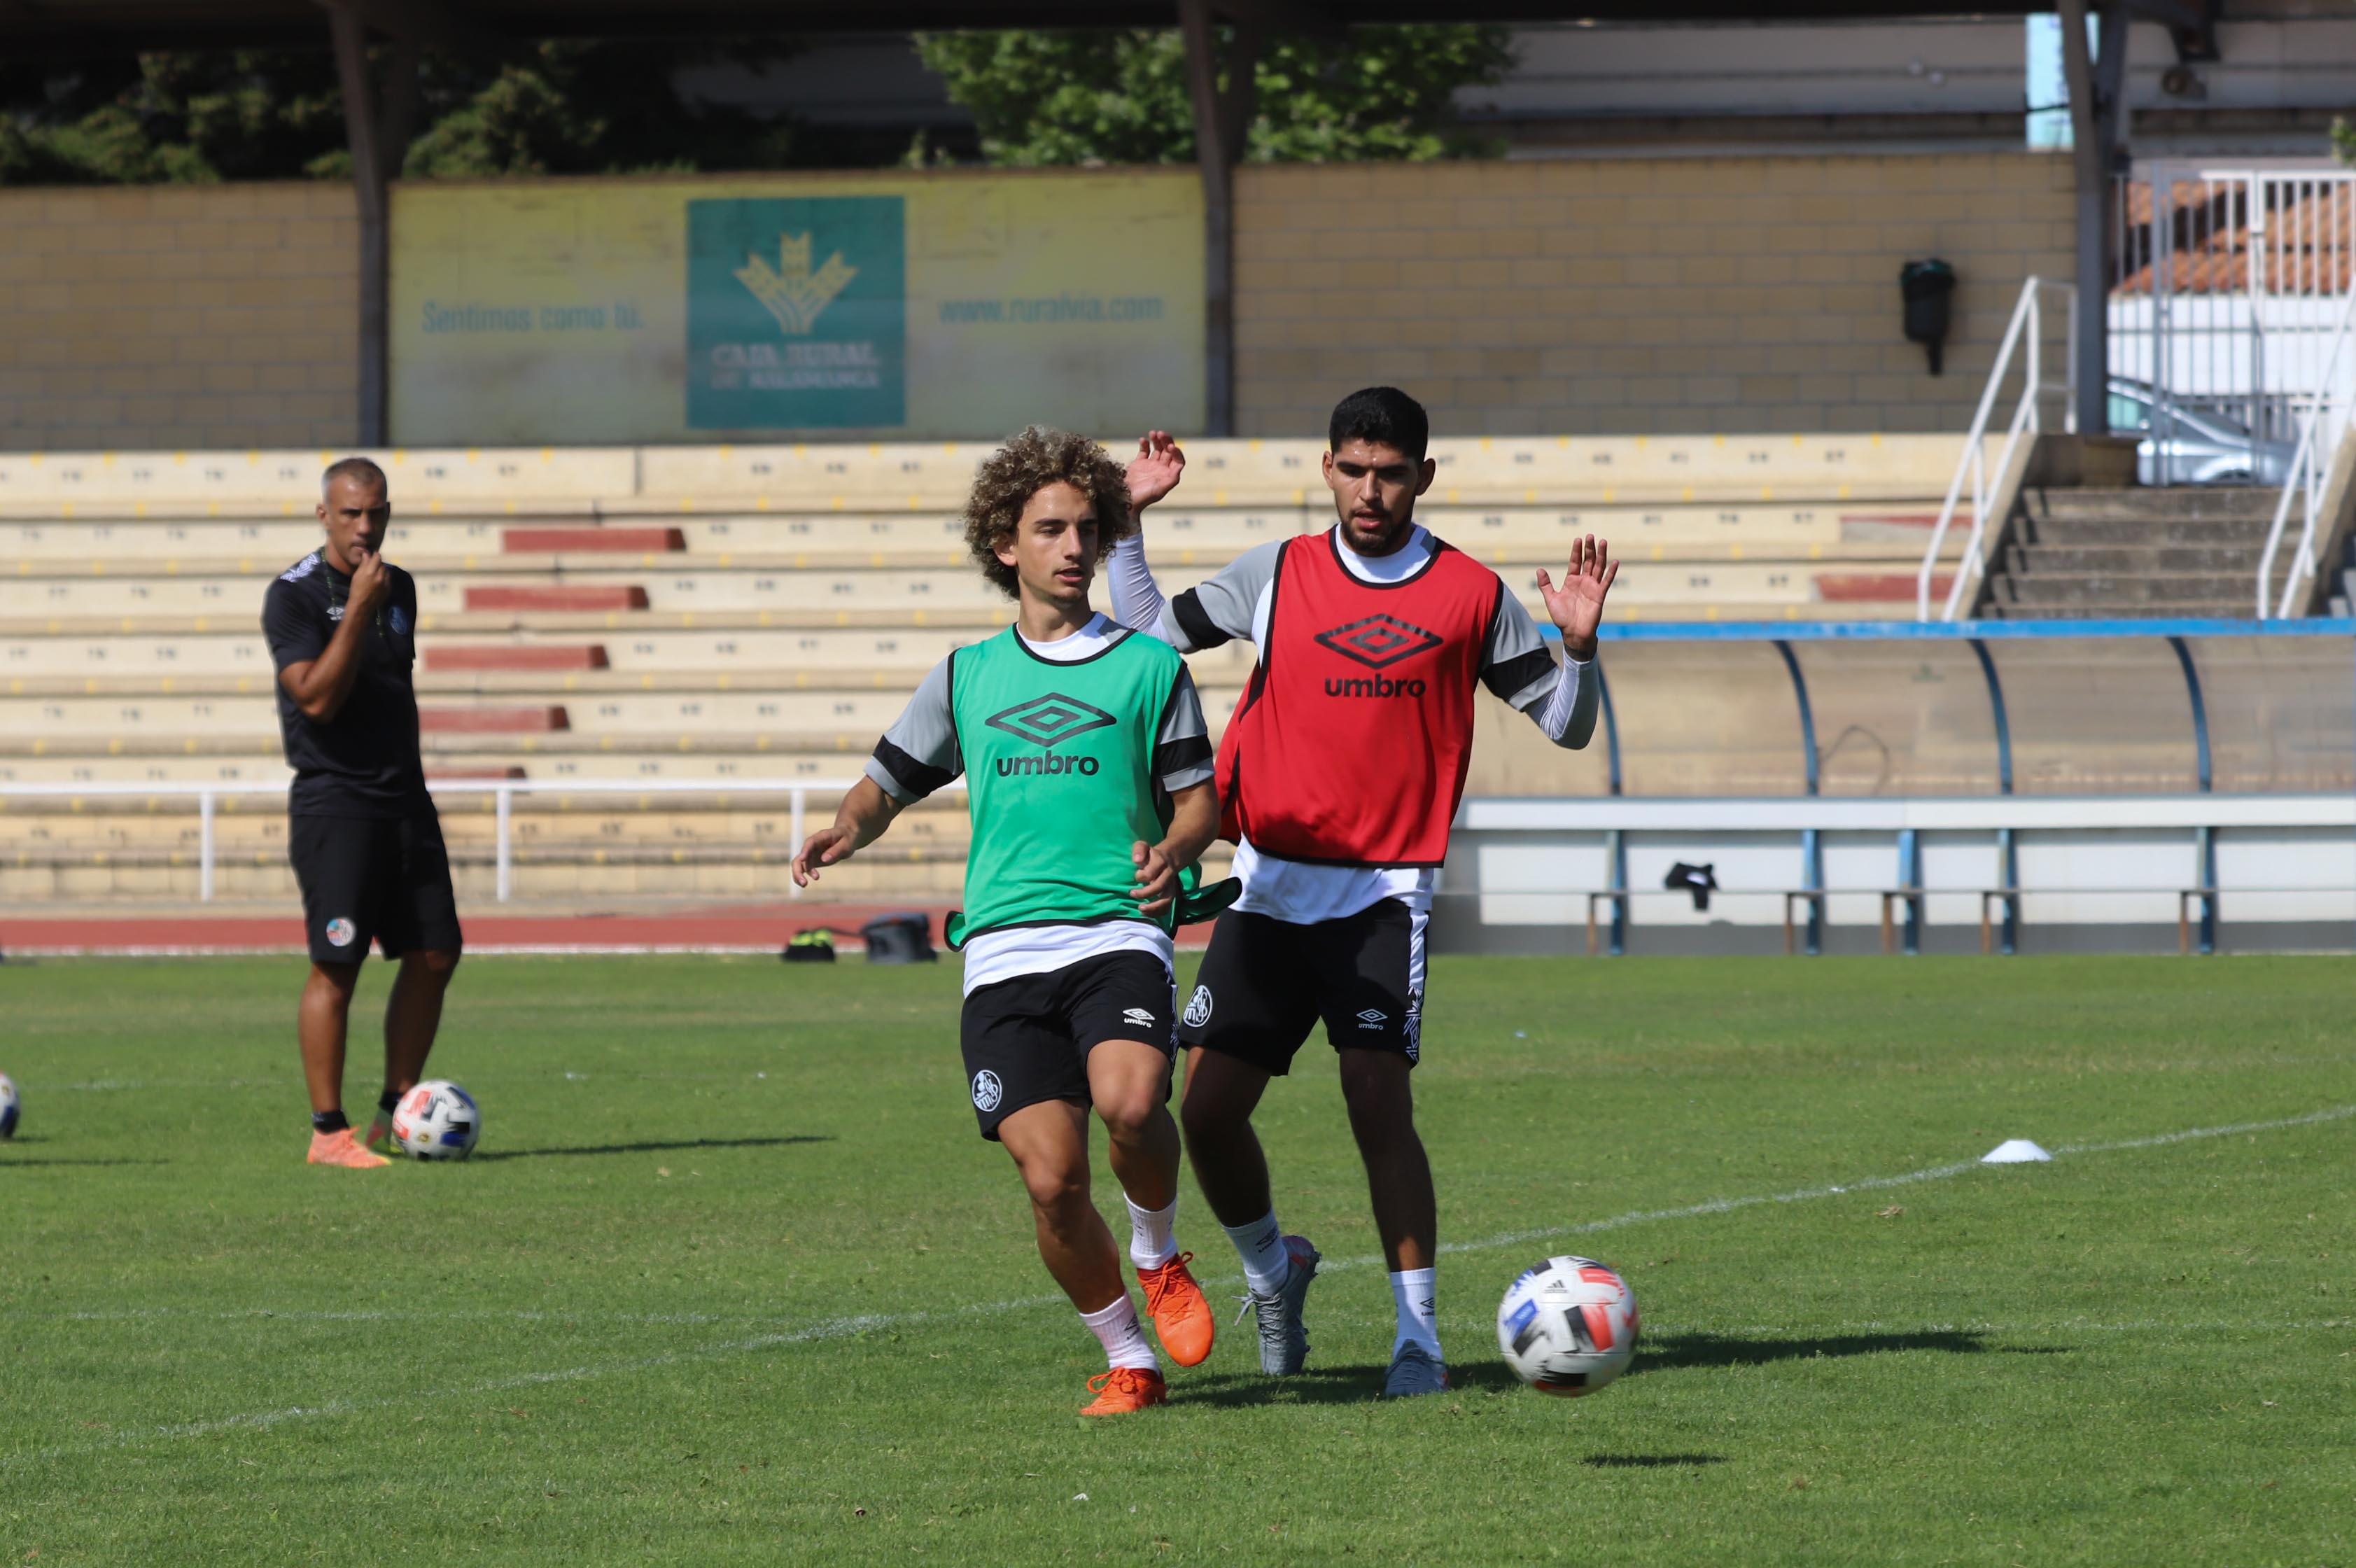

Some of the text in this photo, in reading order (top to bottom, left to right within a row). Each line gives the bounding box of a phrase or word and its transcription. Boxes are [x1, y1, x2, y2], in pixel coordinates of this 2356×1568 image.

[423, 301, 531, 333] Sentimos
[540, 306, 606, 331] como
[940, 293, 1163, 323] www.ruralvia.com
[1325, 673, 1426, 699] umbro
[997, 750, 1100, 777] umbro
[1123, 1018, 1152, 1028] umbro
[1358, 1022, 1384, 1030] umbro
